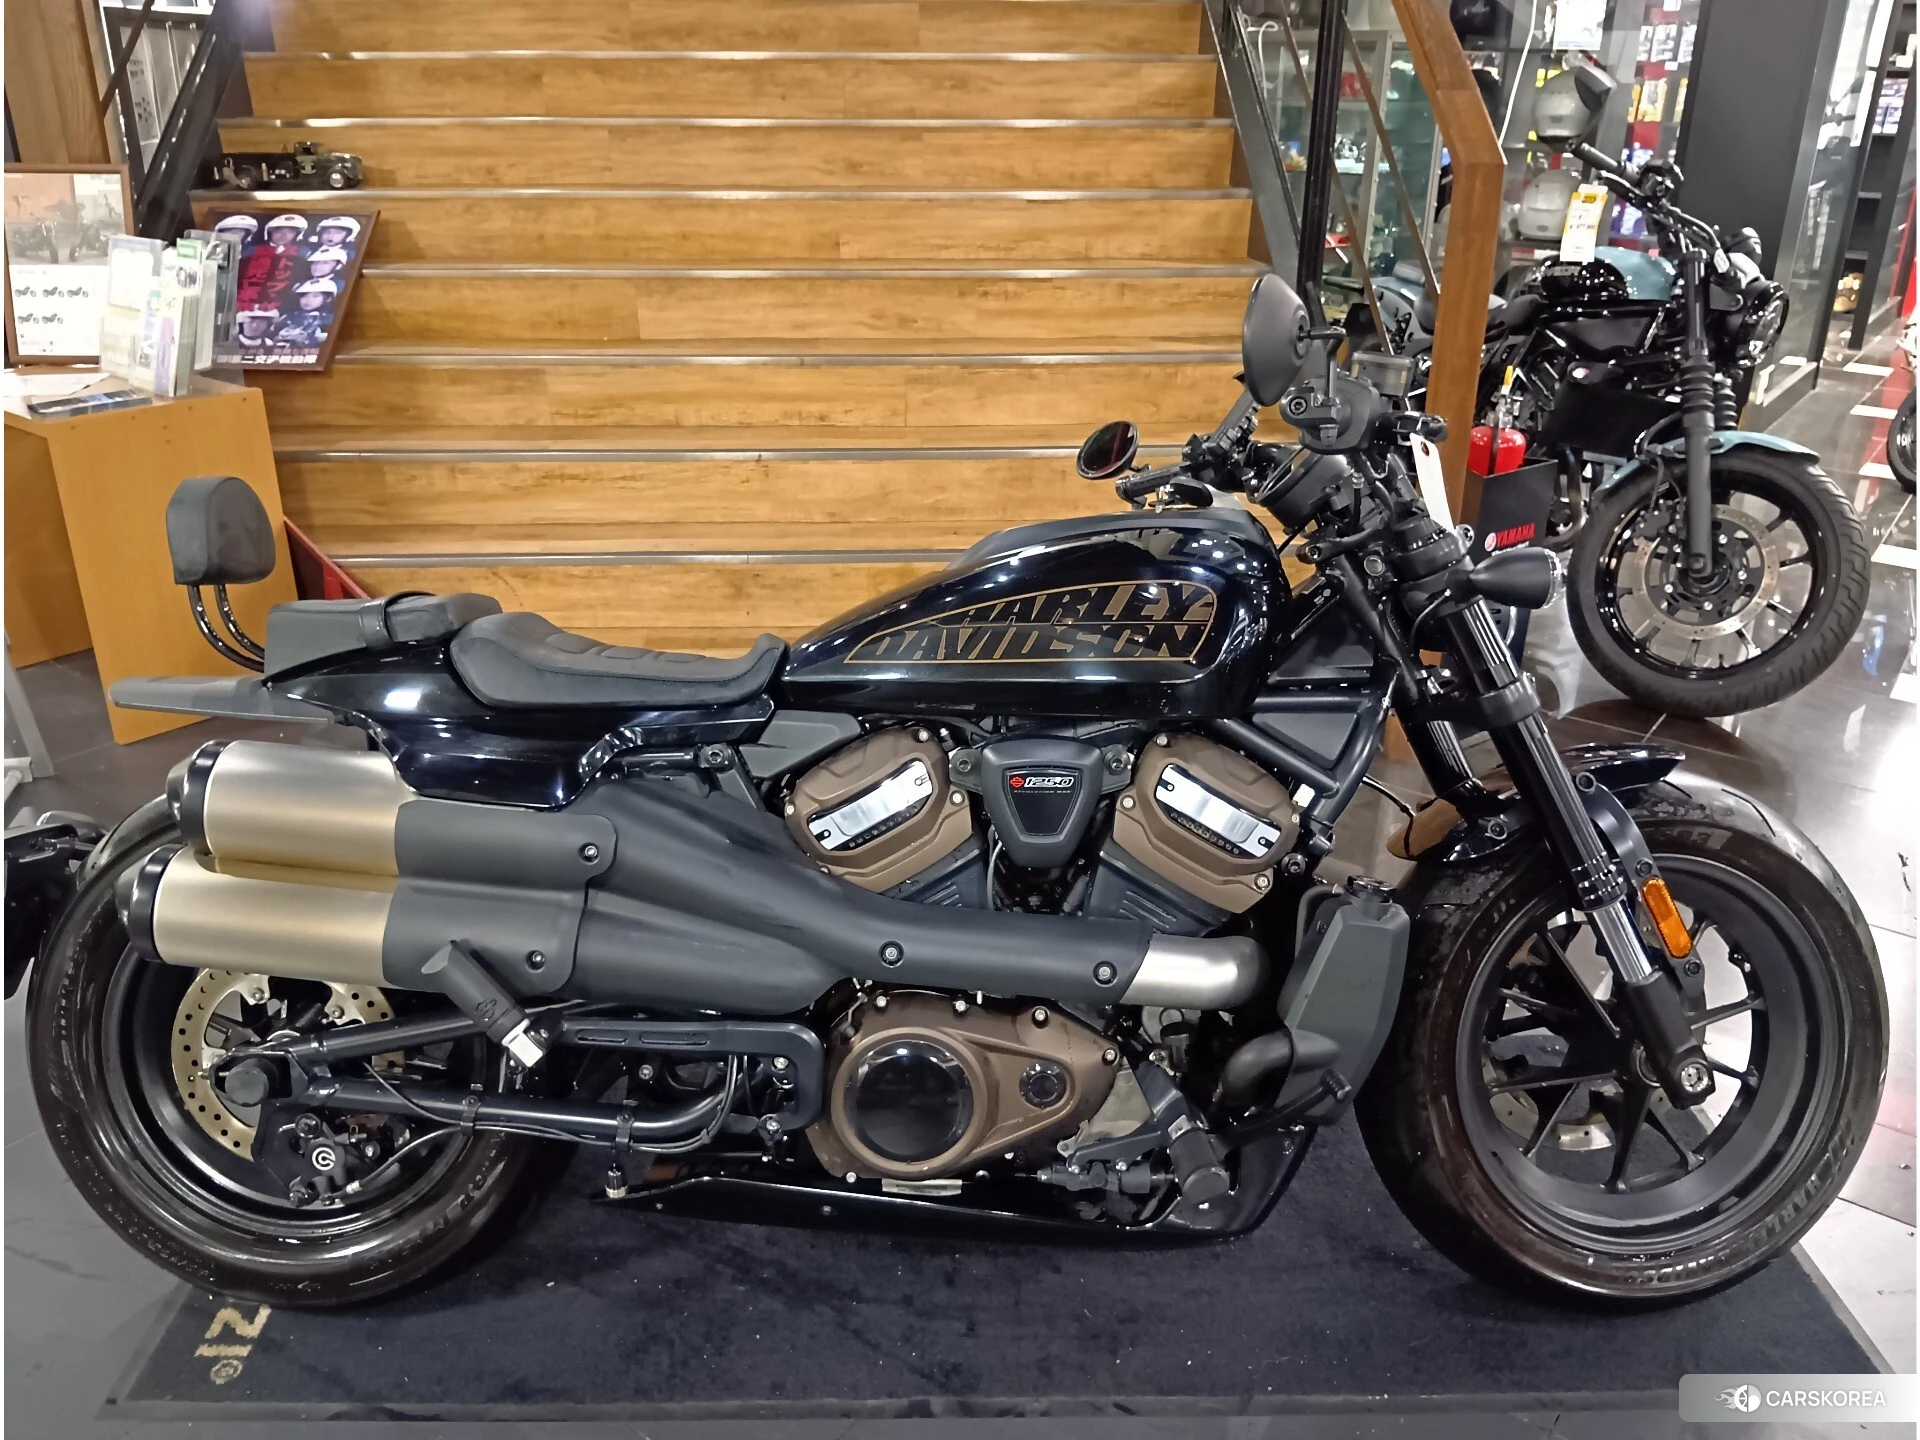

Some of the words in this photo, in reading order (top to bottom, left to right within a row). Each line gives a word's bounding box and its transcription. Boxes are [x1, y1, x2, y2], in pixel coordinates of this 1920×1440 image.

[1497, 523, 1535, 547] YAMAHA
[946, 582, 1213, 627] HARLEY
[856, 624, 1206, 661] DAVIDSON
[1024, 776, 1075, 788] 1250
